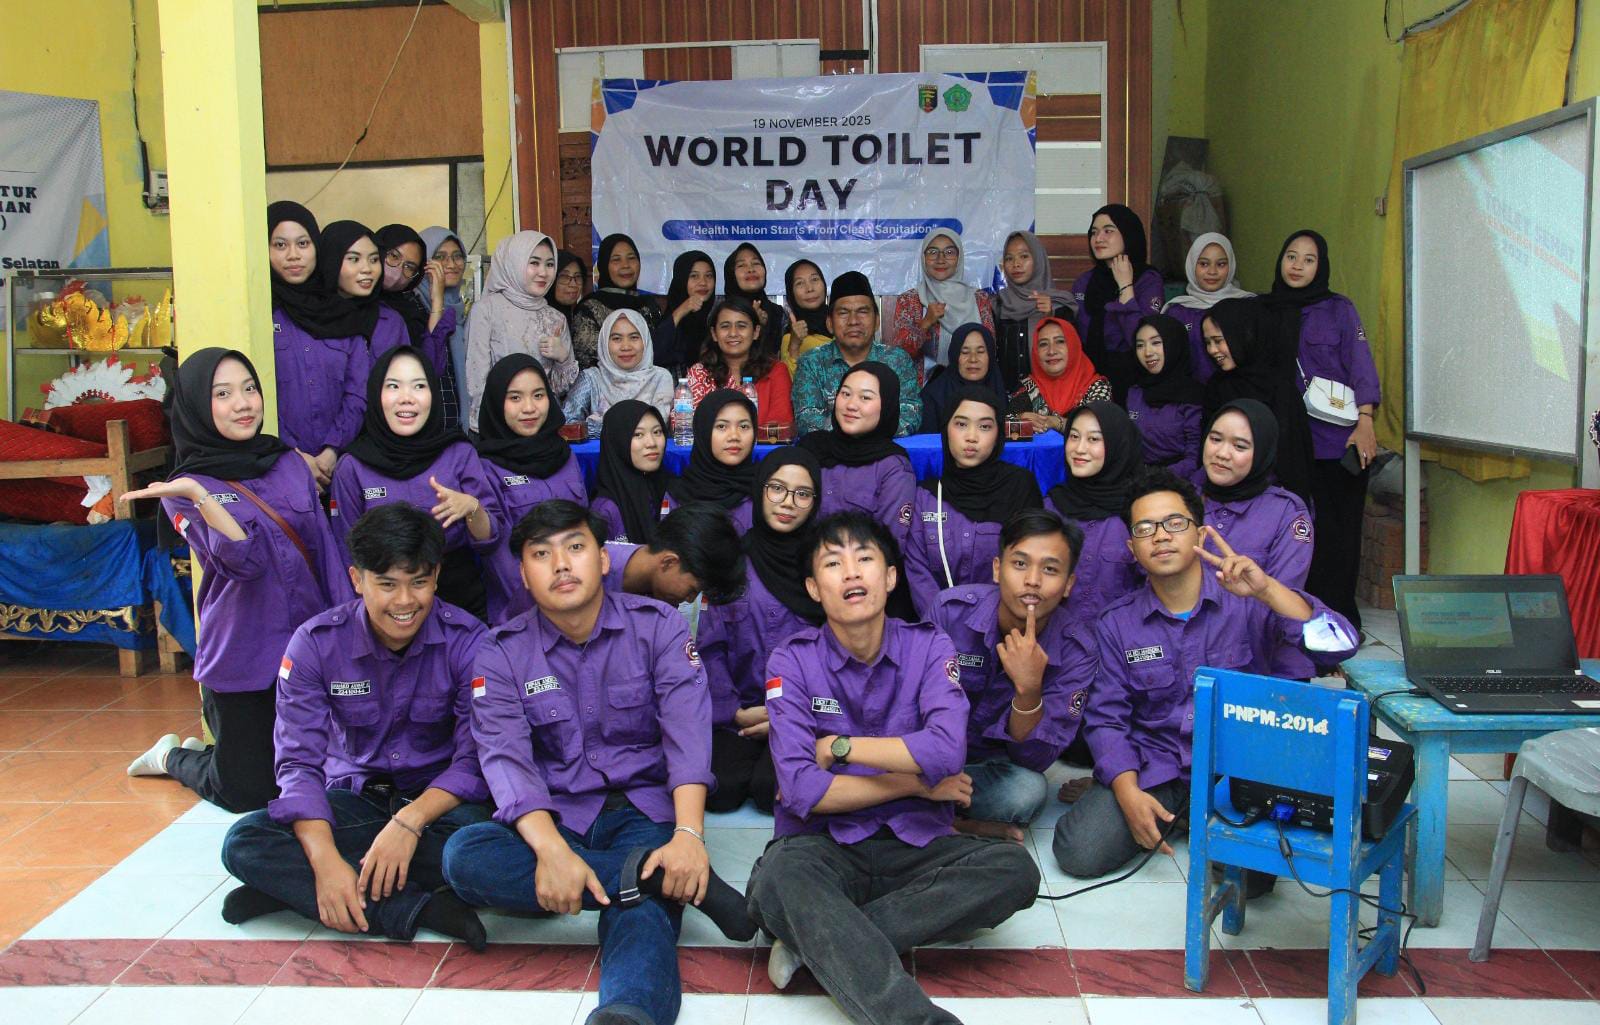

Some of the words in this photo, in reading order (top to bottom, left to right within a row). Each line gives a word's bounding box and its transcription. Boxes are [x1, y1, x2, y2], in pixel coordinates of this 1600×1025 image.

[753, 118, 765, 128] 19
[769, 117, 838, 129] NOVEMBER
[841, 115, 871, 126] 2025
[644, 135, 807, 167] WORLD
[822, 132, 981, 166] TOILET
[766, 178, 857, 211] DAY
[688, 224, 729, 235] "Health
[731, 224, 768, 235] Nation
[770, 224, 805, 235] Starts
[808, 224, 836, 235] From
[839, 224, 872, 235] Clean
[2, 257, 60, 269] Selatan
[1223, 702, 1329, 736] PNPM:2014
